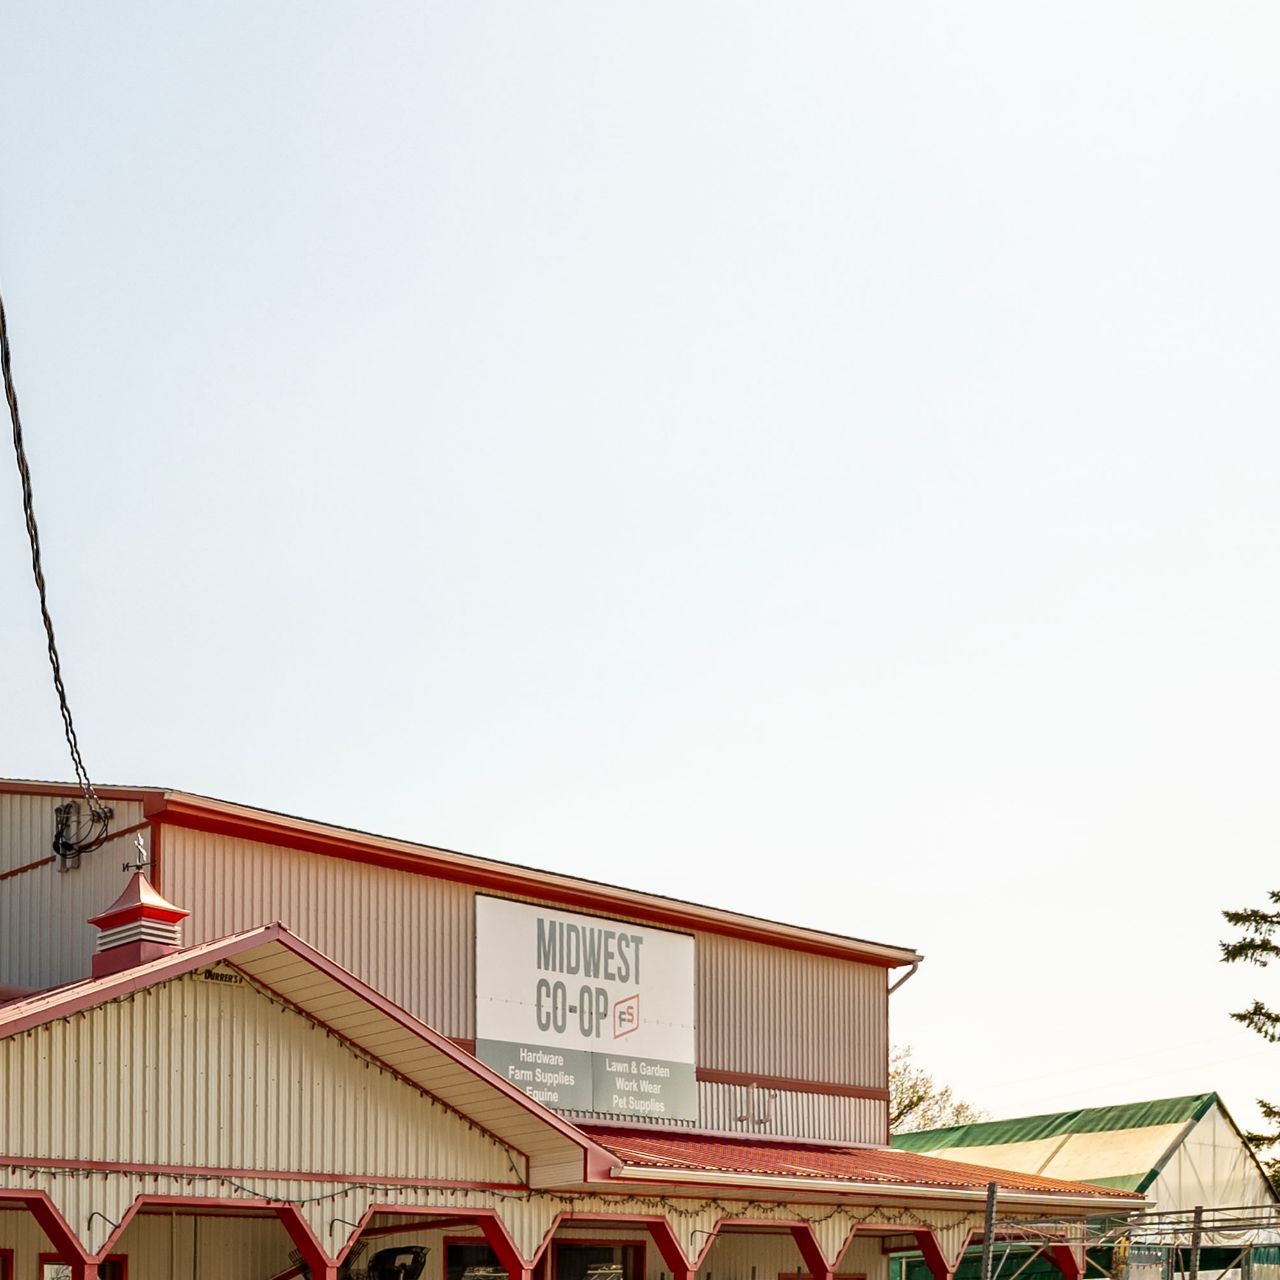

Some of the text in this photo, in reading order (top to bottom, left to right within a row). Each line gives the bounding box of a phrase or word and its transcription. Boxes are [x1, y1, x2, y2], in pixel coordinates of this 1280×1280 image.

[536, 918, 643, 984] MIDWEST
[536, 978, 608, 1038] CO-OP
[618, 1005, 634, 1027] FS
[520, 1048, 564, 1066] Hardware
[508, 1066, 575, 1086] Farm Supplies
[606, 1058, 670, 1078] Lawn & Garden
[526, 1086, 558, 1103] Equine
[615, 1078, 662, 1095] Work Wear
[613, 1095, 665, 1113] Pet Supplies
